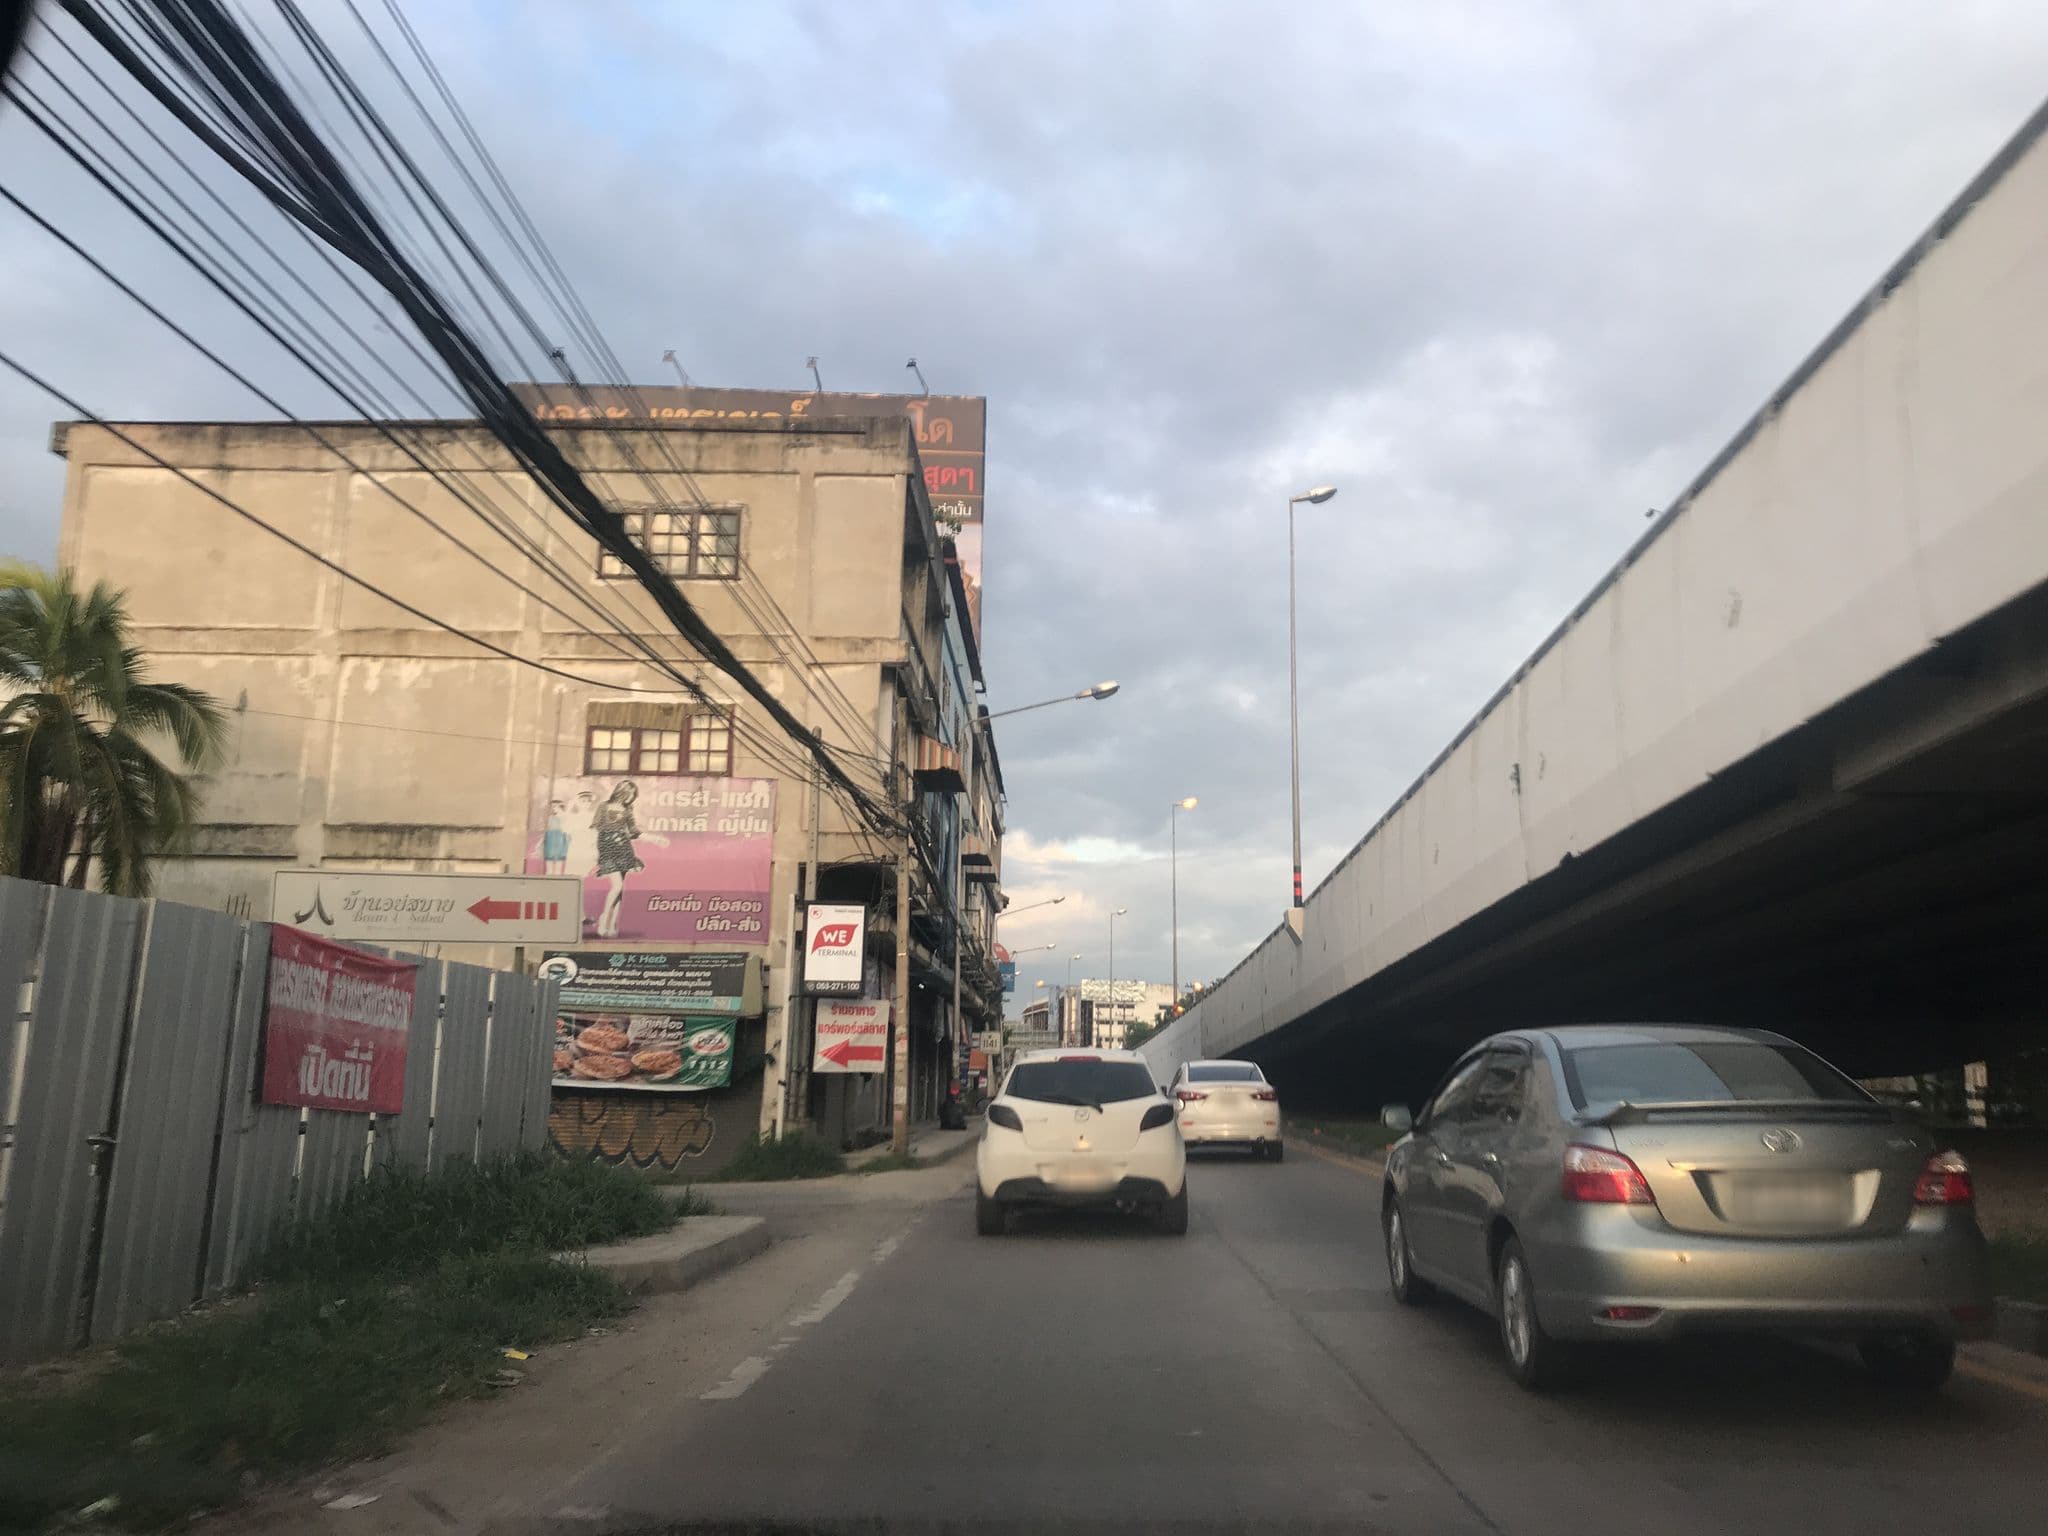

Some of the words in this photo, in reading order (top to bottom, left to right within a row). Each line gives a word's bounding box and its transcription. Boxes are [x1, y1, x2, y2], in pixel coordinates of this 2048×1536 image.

[647, 893, 702, 912] มือหนึ่ง
[708, 896, 762, 913] มือสอง
[695, 914, 762, 932] ปลีก-ส่ง
[822, 929, 849, 944] WE
[817, 948, 858, 957] TERMINAL
[831, 1001, 877, 1017] ร้านอาหาร
[299, 1039, 375, 1101] เปิดที่นี่
[688, 1060, 729, 1071] 1112
